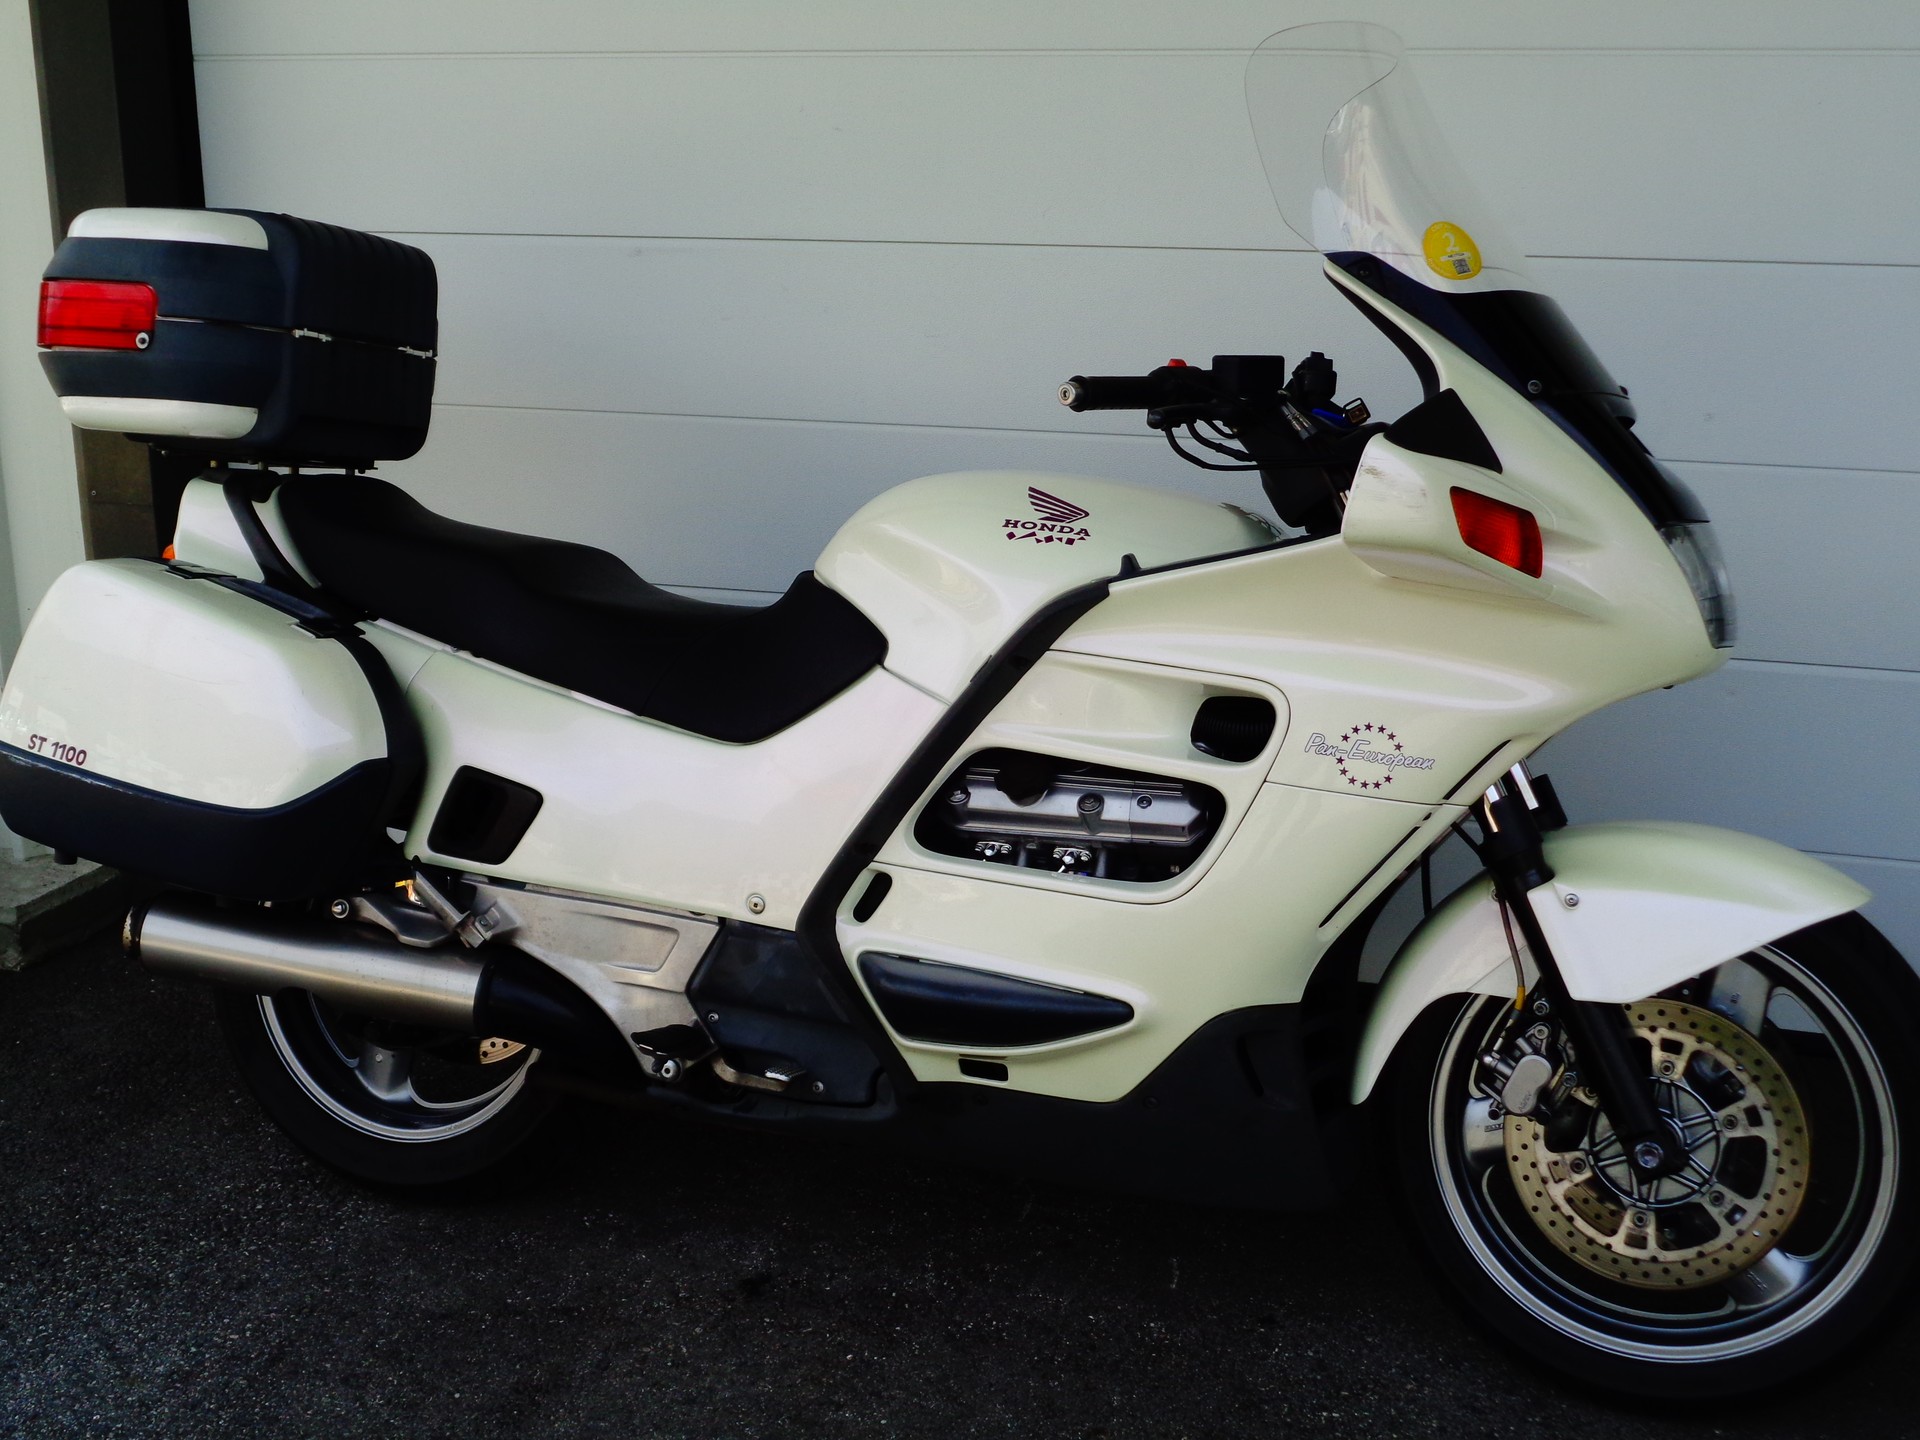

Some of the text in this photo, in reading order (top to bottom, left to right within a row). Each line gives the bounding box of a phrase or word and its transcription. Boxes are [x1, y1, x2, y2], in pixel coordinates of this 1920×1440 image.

[1442, 231, 1461, 253] 2
[1002, 519, 1091, 537] HONDA
[28, 733, 87, 766] ST 1100
[1304, 732, 1436, 773] Pan-European
